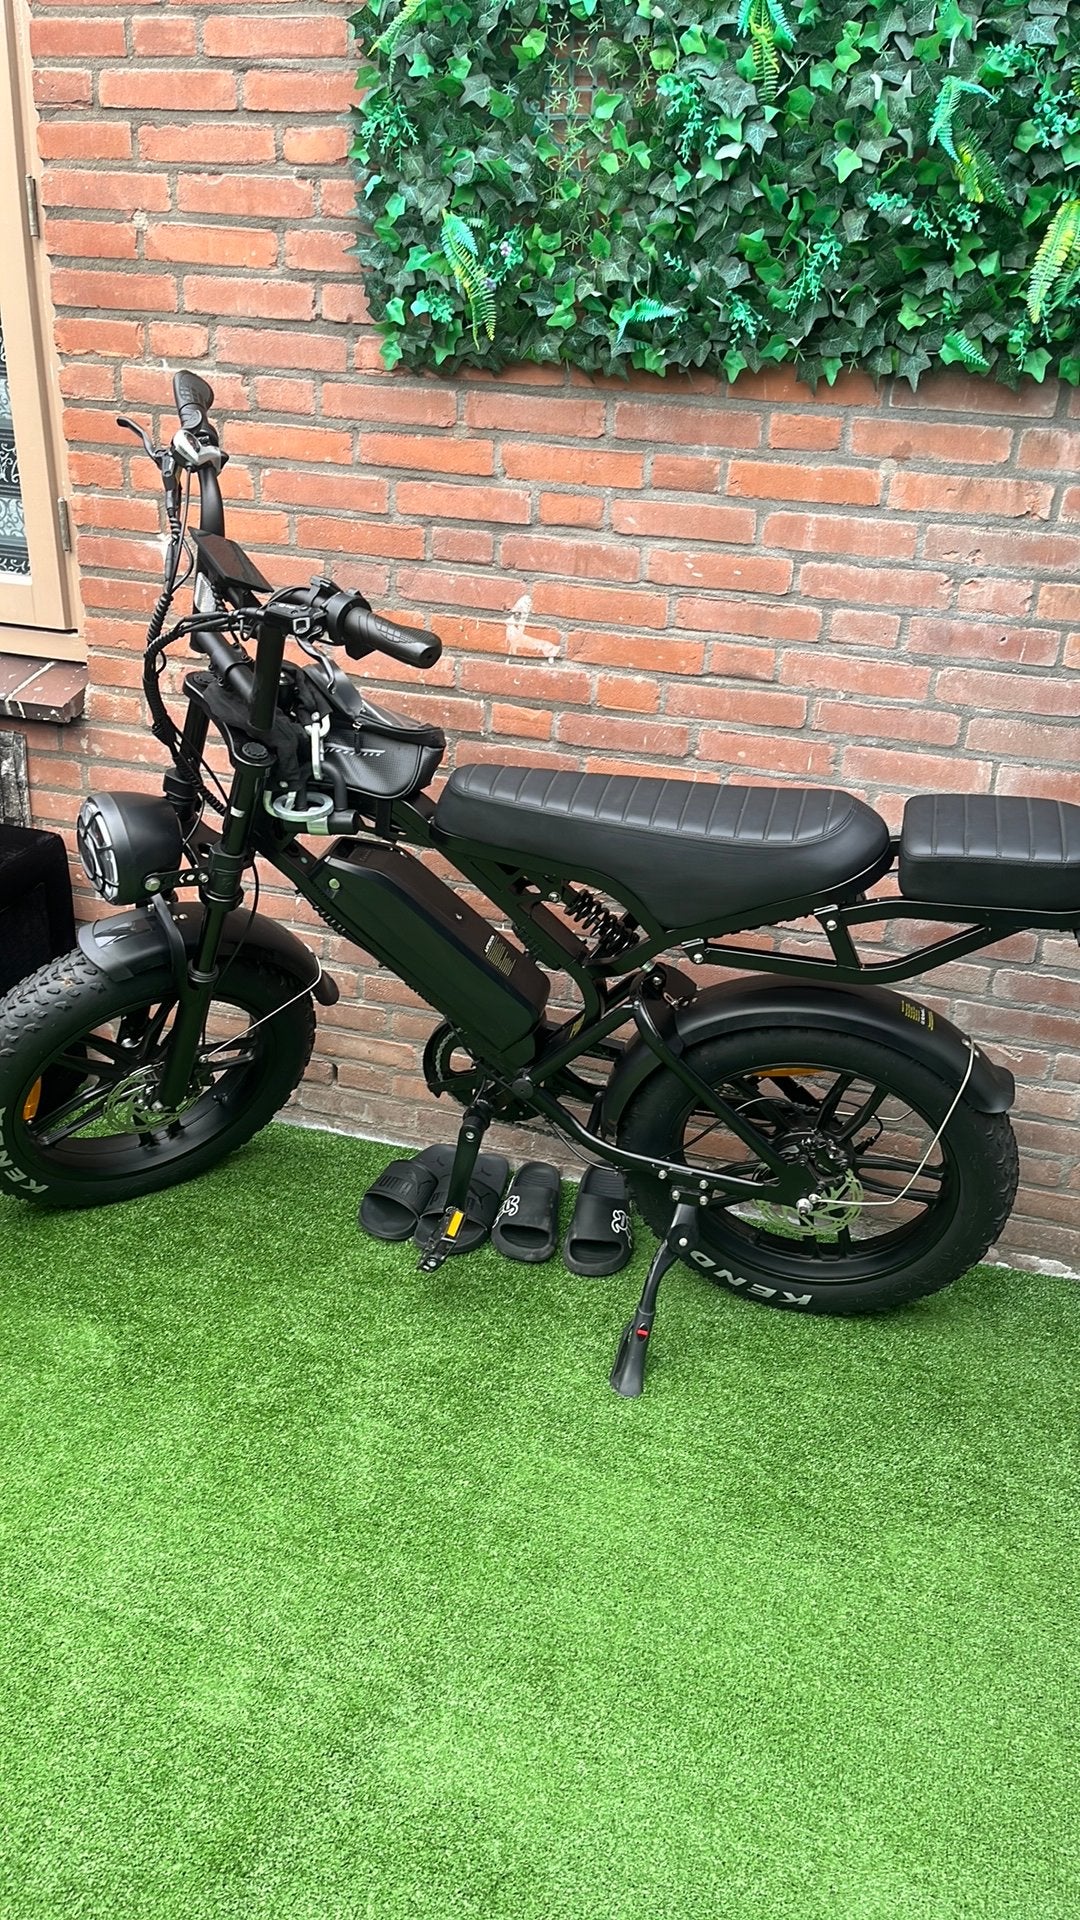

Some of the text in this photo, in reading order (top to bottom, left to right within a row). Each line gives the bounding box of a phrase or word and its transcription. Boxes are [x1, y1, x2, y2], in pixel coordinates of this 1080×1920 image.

[0, 1107, 49, 1194] KEN
[376, 1174, 413, 1196] UMA
[689, 1250, 813, 1305] KEND
